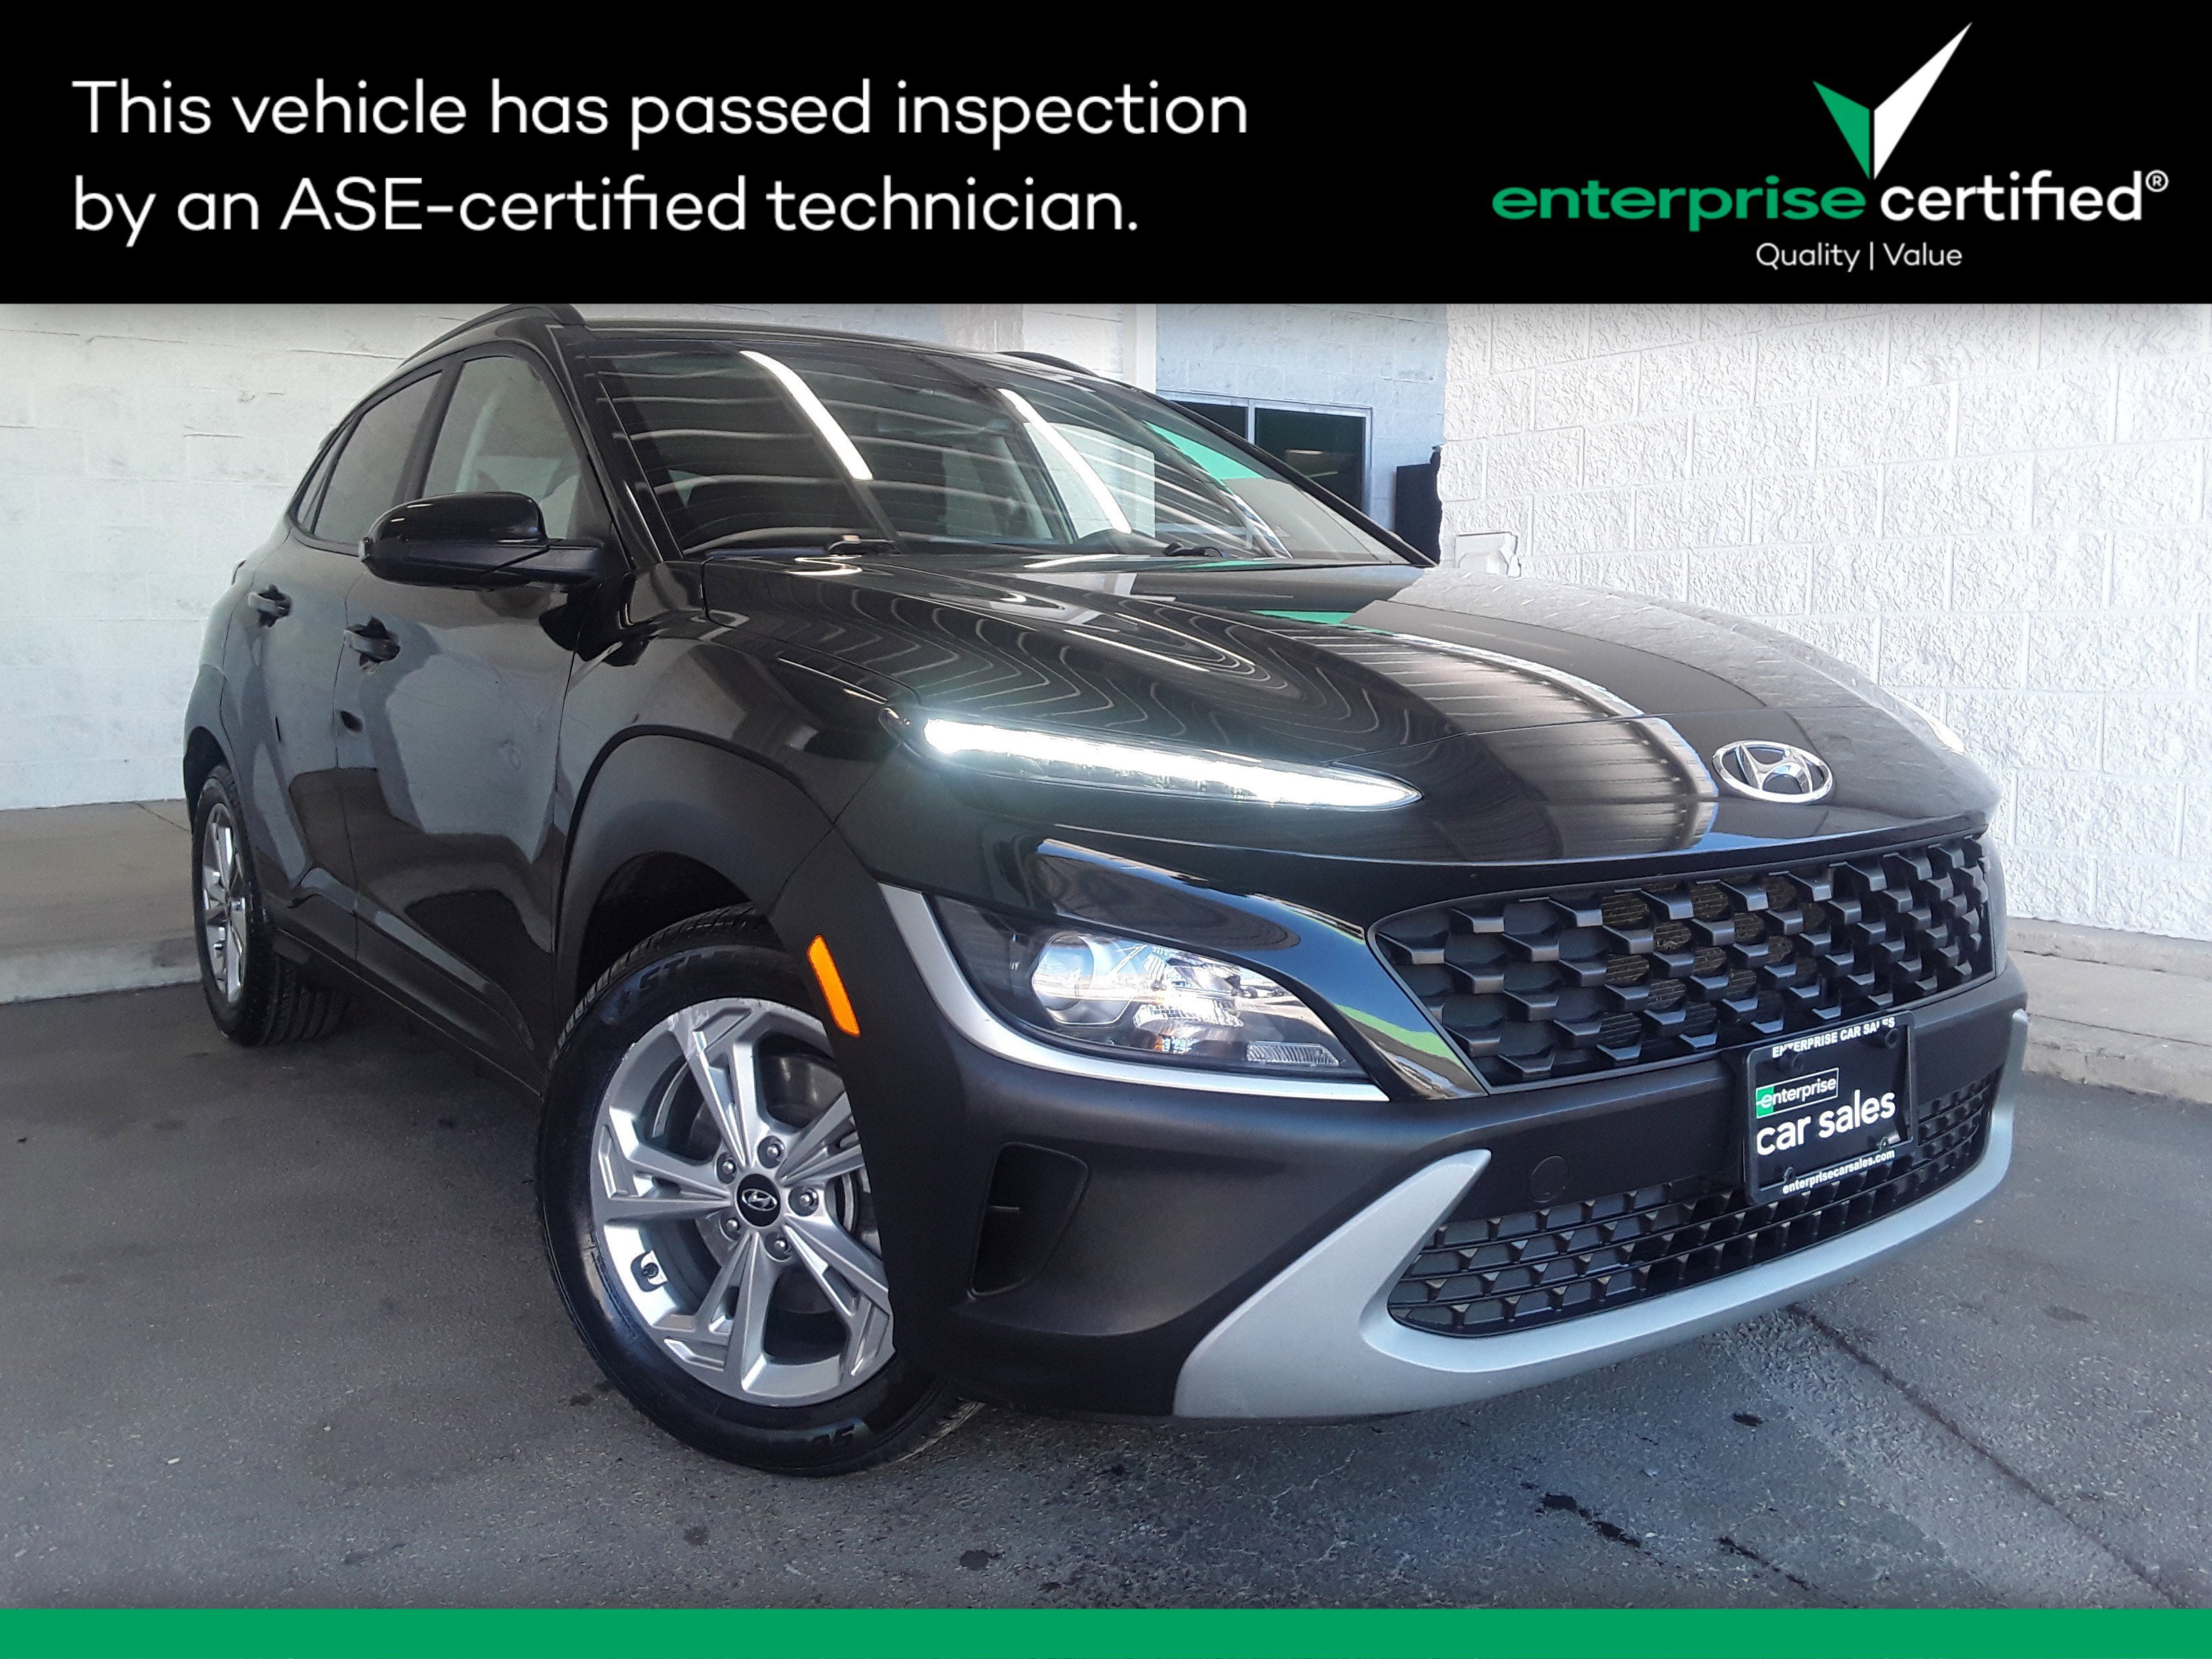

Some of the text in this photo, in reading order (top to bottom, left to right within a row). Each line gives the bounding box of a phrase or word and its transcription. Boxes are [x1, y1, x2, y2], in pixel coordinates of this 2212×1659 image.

[1840, 1027, 1861, 1040] CAR
[1757, 1078, 1836, 1109] enterprise
[1757, 1089, 1896, 1155] car sales
[1782, 1149, 1895, 1194] enterprisecarsales.com
